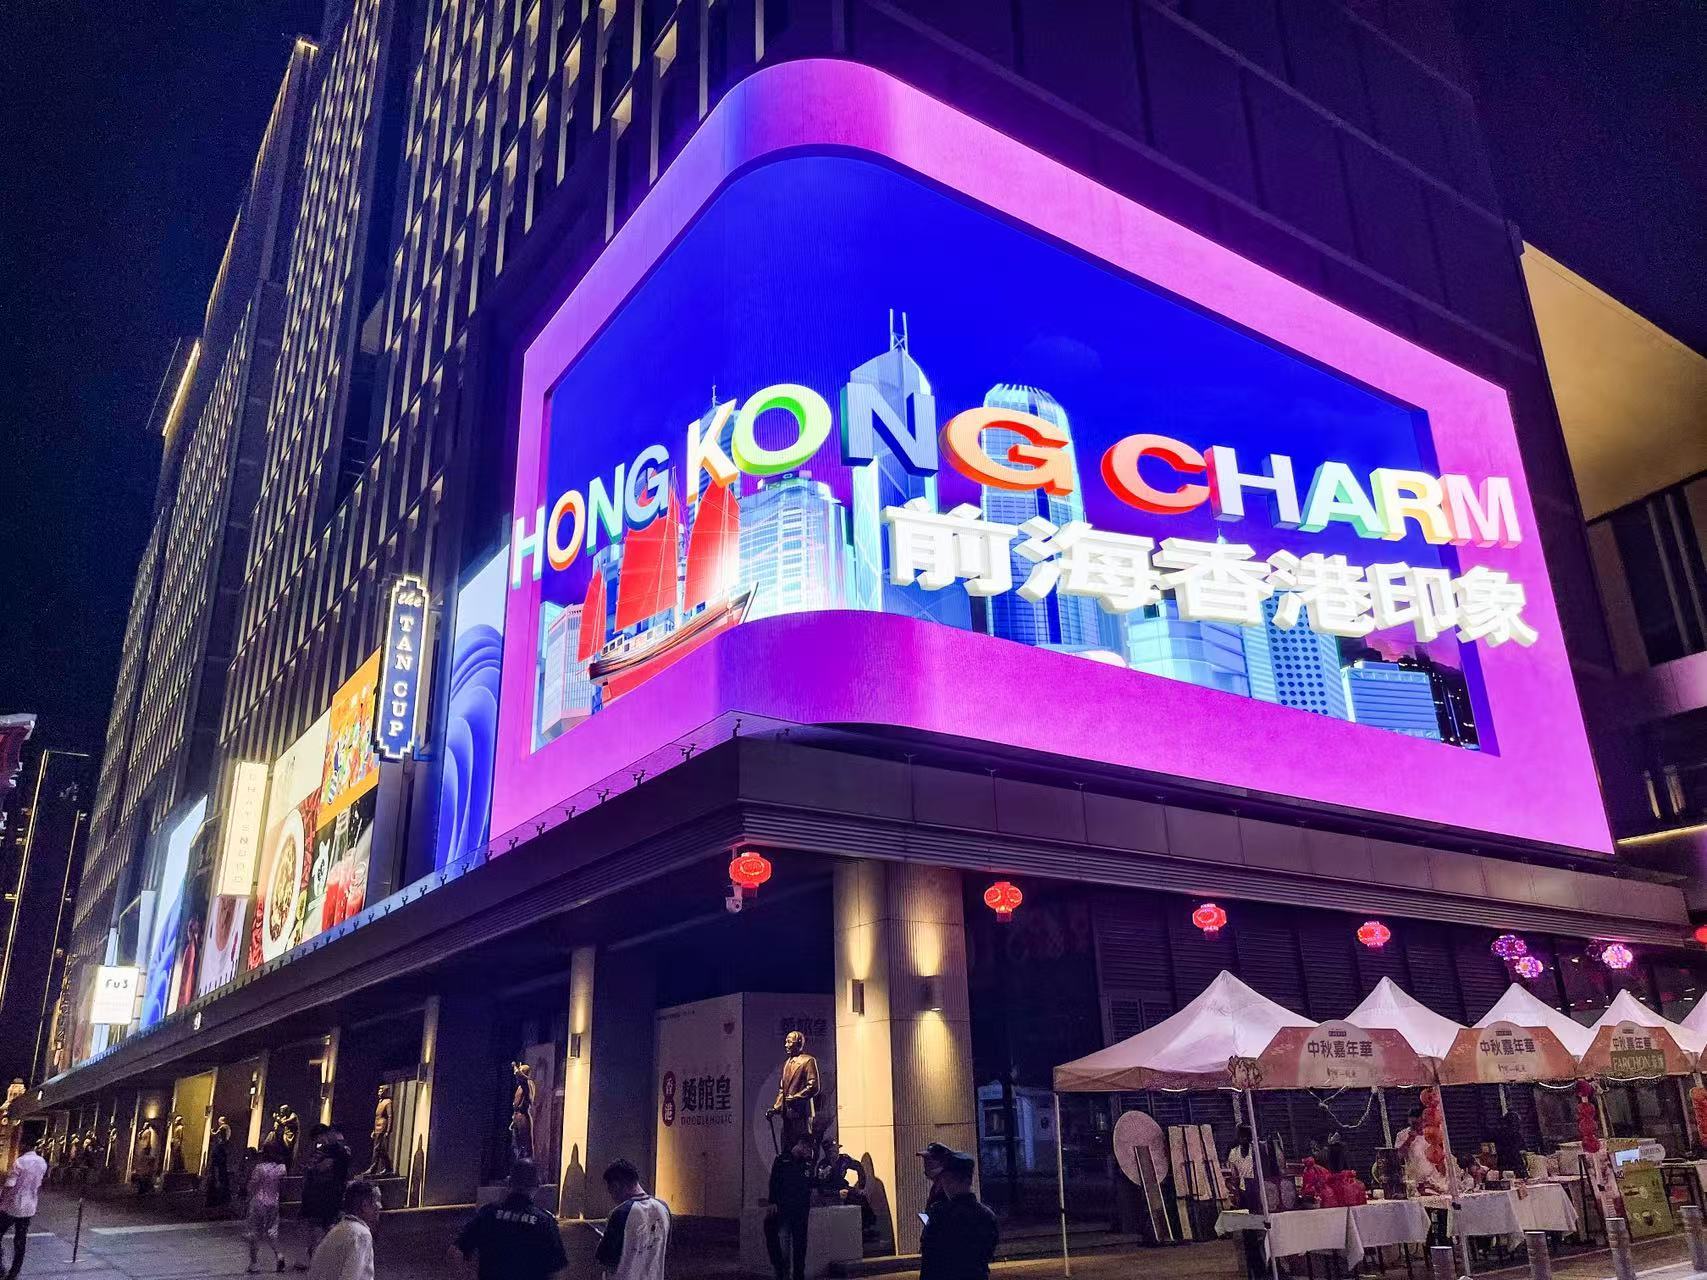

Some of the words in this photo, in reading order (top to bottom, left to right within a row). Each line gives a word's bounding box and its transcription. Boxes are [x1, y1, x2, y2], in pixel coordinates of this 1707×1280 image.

[511, 444, 670, 588] HONG
[687, 383, 1074, 496] KONG
[1100, 434, 1521, 549] CHARM
[397, 590, 422, 607] the
[881, 497, 1539, 648] 前海香港印象
[395, 615, 415, 671] TAN
[388, 681, 409, 737] CUP
[1307, 1040, 1374, 1058] 中秋嘉年華
[1479, 1038, 1537, 1056] 中秋嘉年華
